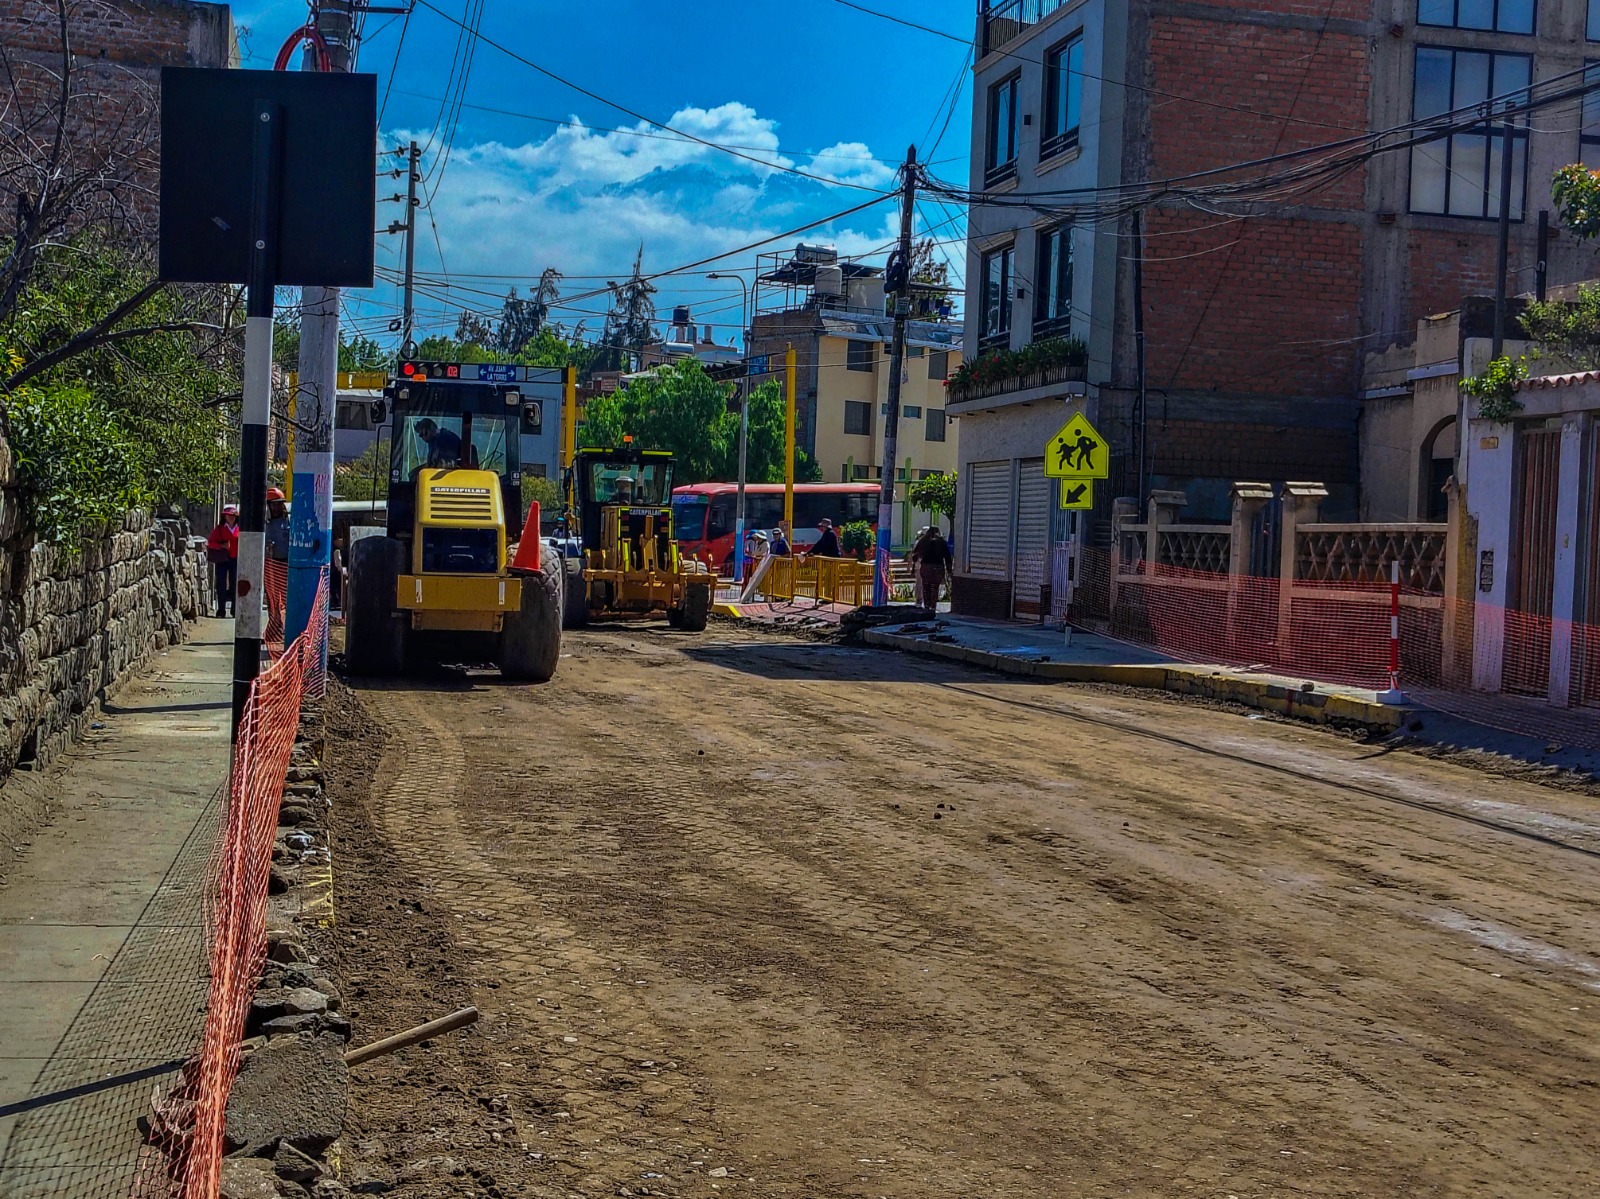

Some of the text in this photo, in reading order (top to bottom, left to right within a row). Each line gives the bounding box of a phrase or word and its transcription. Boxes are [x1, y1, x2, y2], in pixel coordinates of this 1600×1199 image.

[447, 366, 458, 377] 02
[495, 365, 507, 373] JUAN
[493, 373, 507, 381] TORRE
